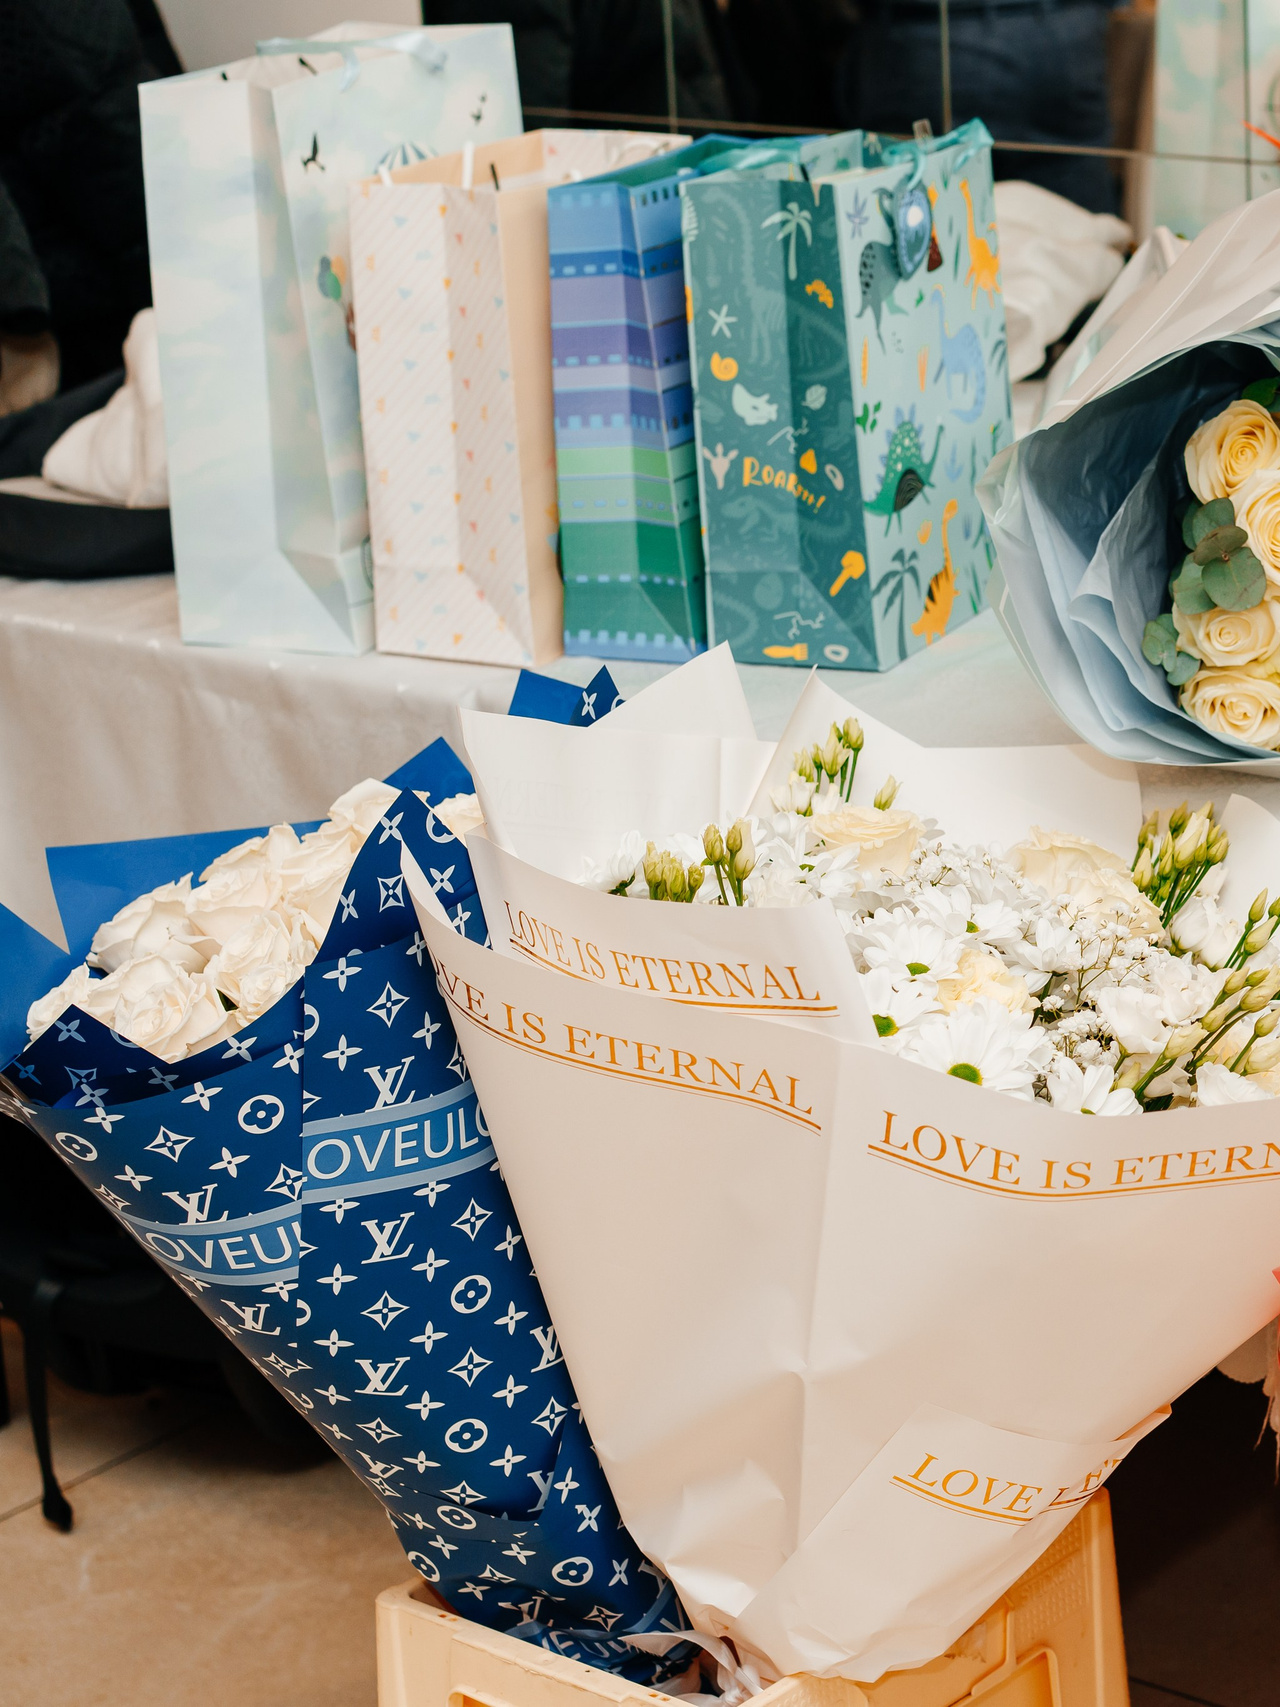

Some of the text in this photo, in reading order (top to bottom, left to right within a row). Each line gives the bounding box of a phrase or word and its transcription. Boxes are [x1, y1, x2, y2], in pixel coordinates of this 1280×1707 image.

[502, 900, 821, 1001] LOVE IS ETERNAL
[501, 1002, 546, 1044] IS
[563, 1024, 813, 1115] ETERNAL
[879, 1110, 1021, 1187] LOVE
[1039, 1159, 1092, 1190] IS
[908, 1452, 1043, 1514] LOVE
